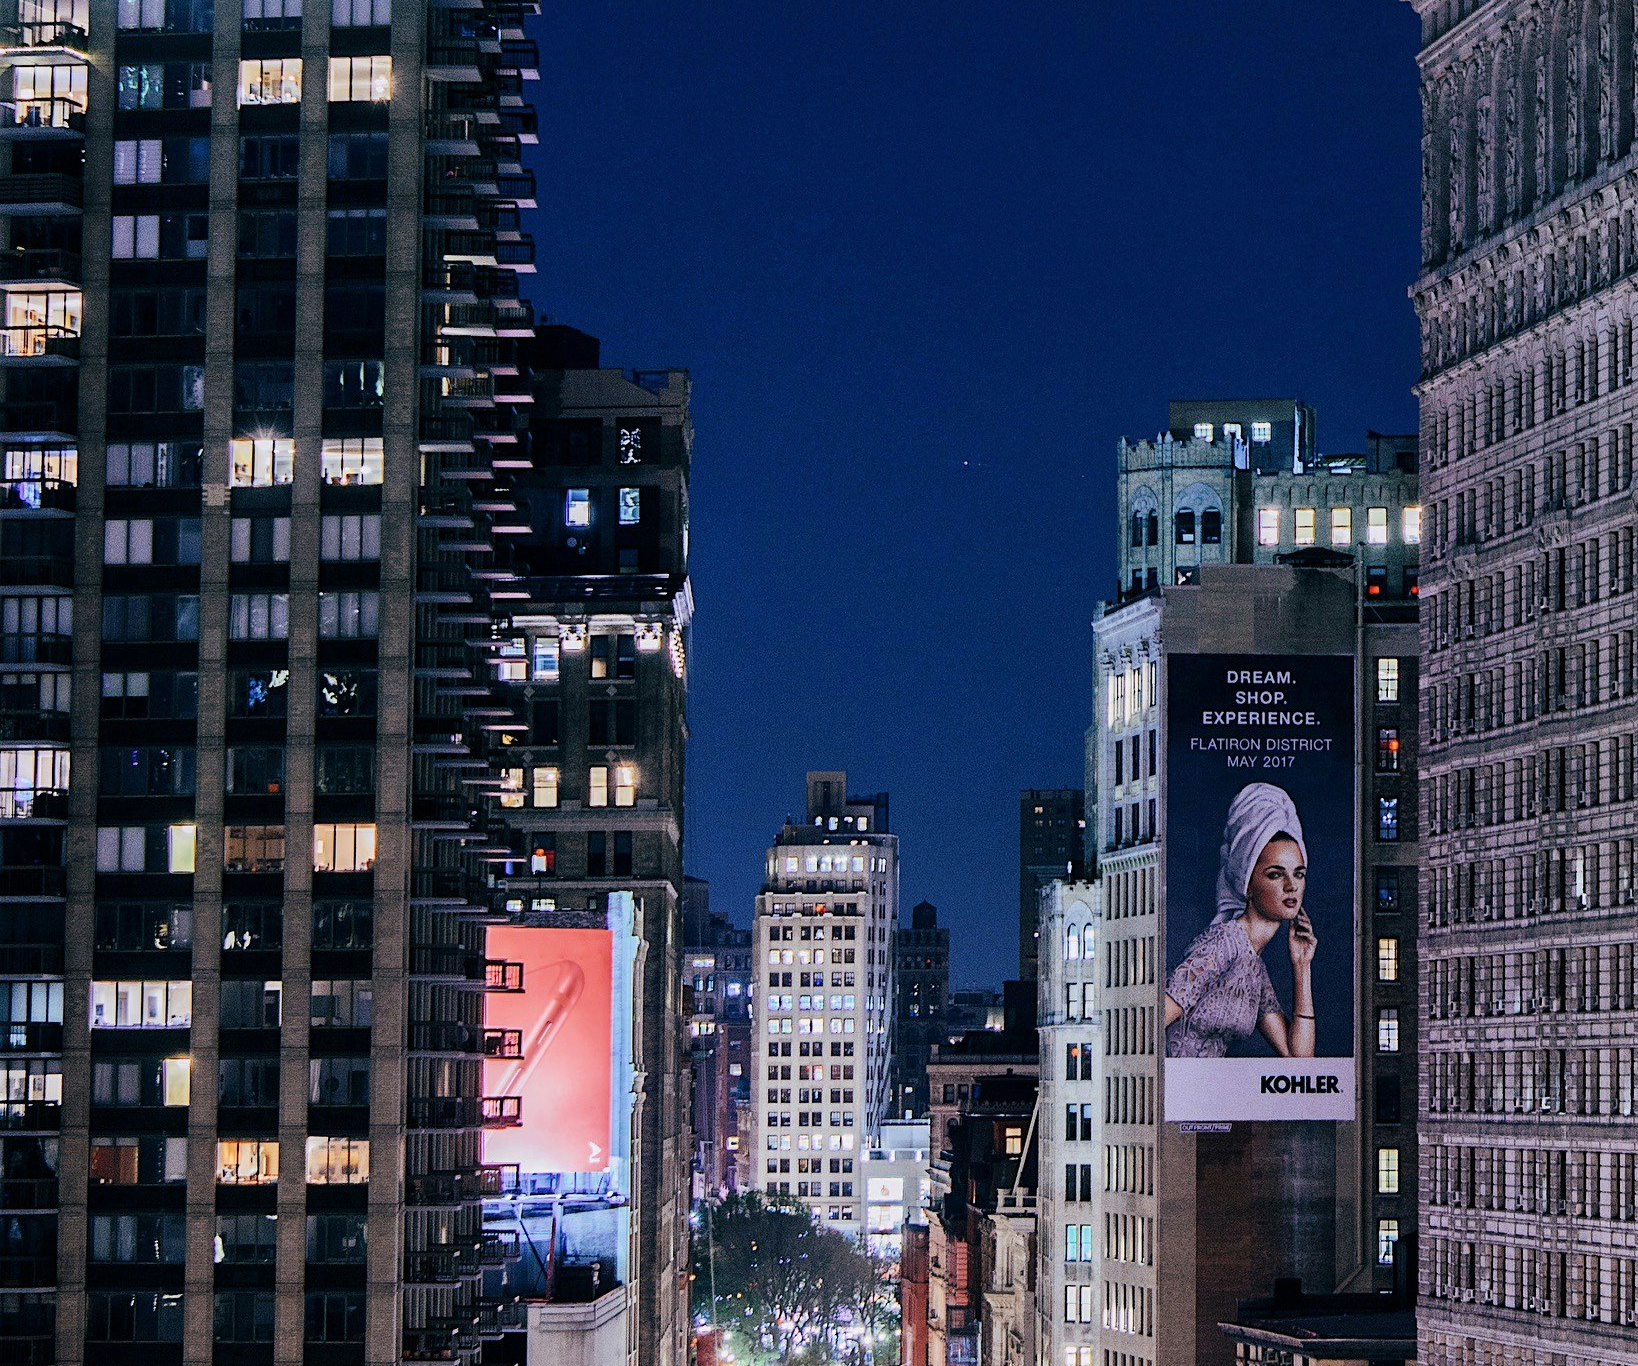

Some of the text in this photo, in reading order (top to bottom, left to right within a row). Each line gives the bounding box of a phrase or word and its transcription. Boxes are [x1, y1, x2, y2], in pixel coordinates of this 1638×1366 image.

[1227, 670, 1297, 684] DREAM.
[1235, 691, 1287, 705] SHOP.
[1202, 711, 1320, 725] EXPERIENCE.
[1190, 738, 1332, 751] FLATIRON DISTRICT
[1227, 755, 1295, 768] MAY 2017
[1260, 1075, 1340, 1094] KOHLER
